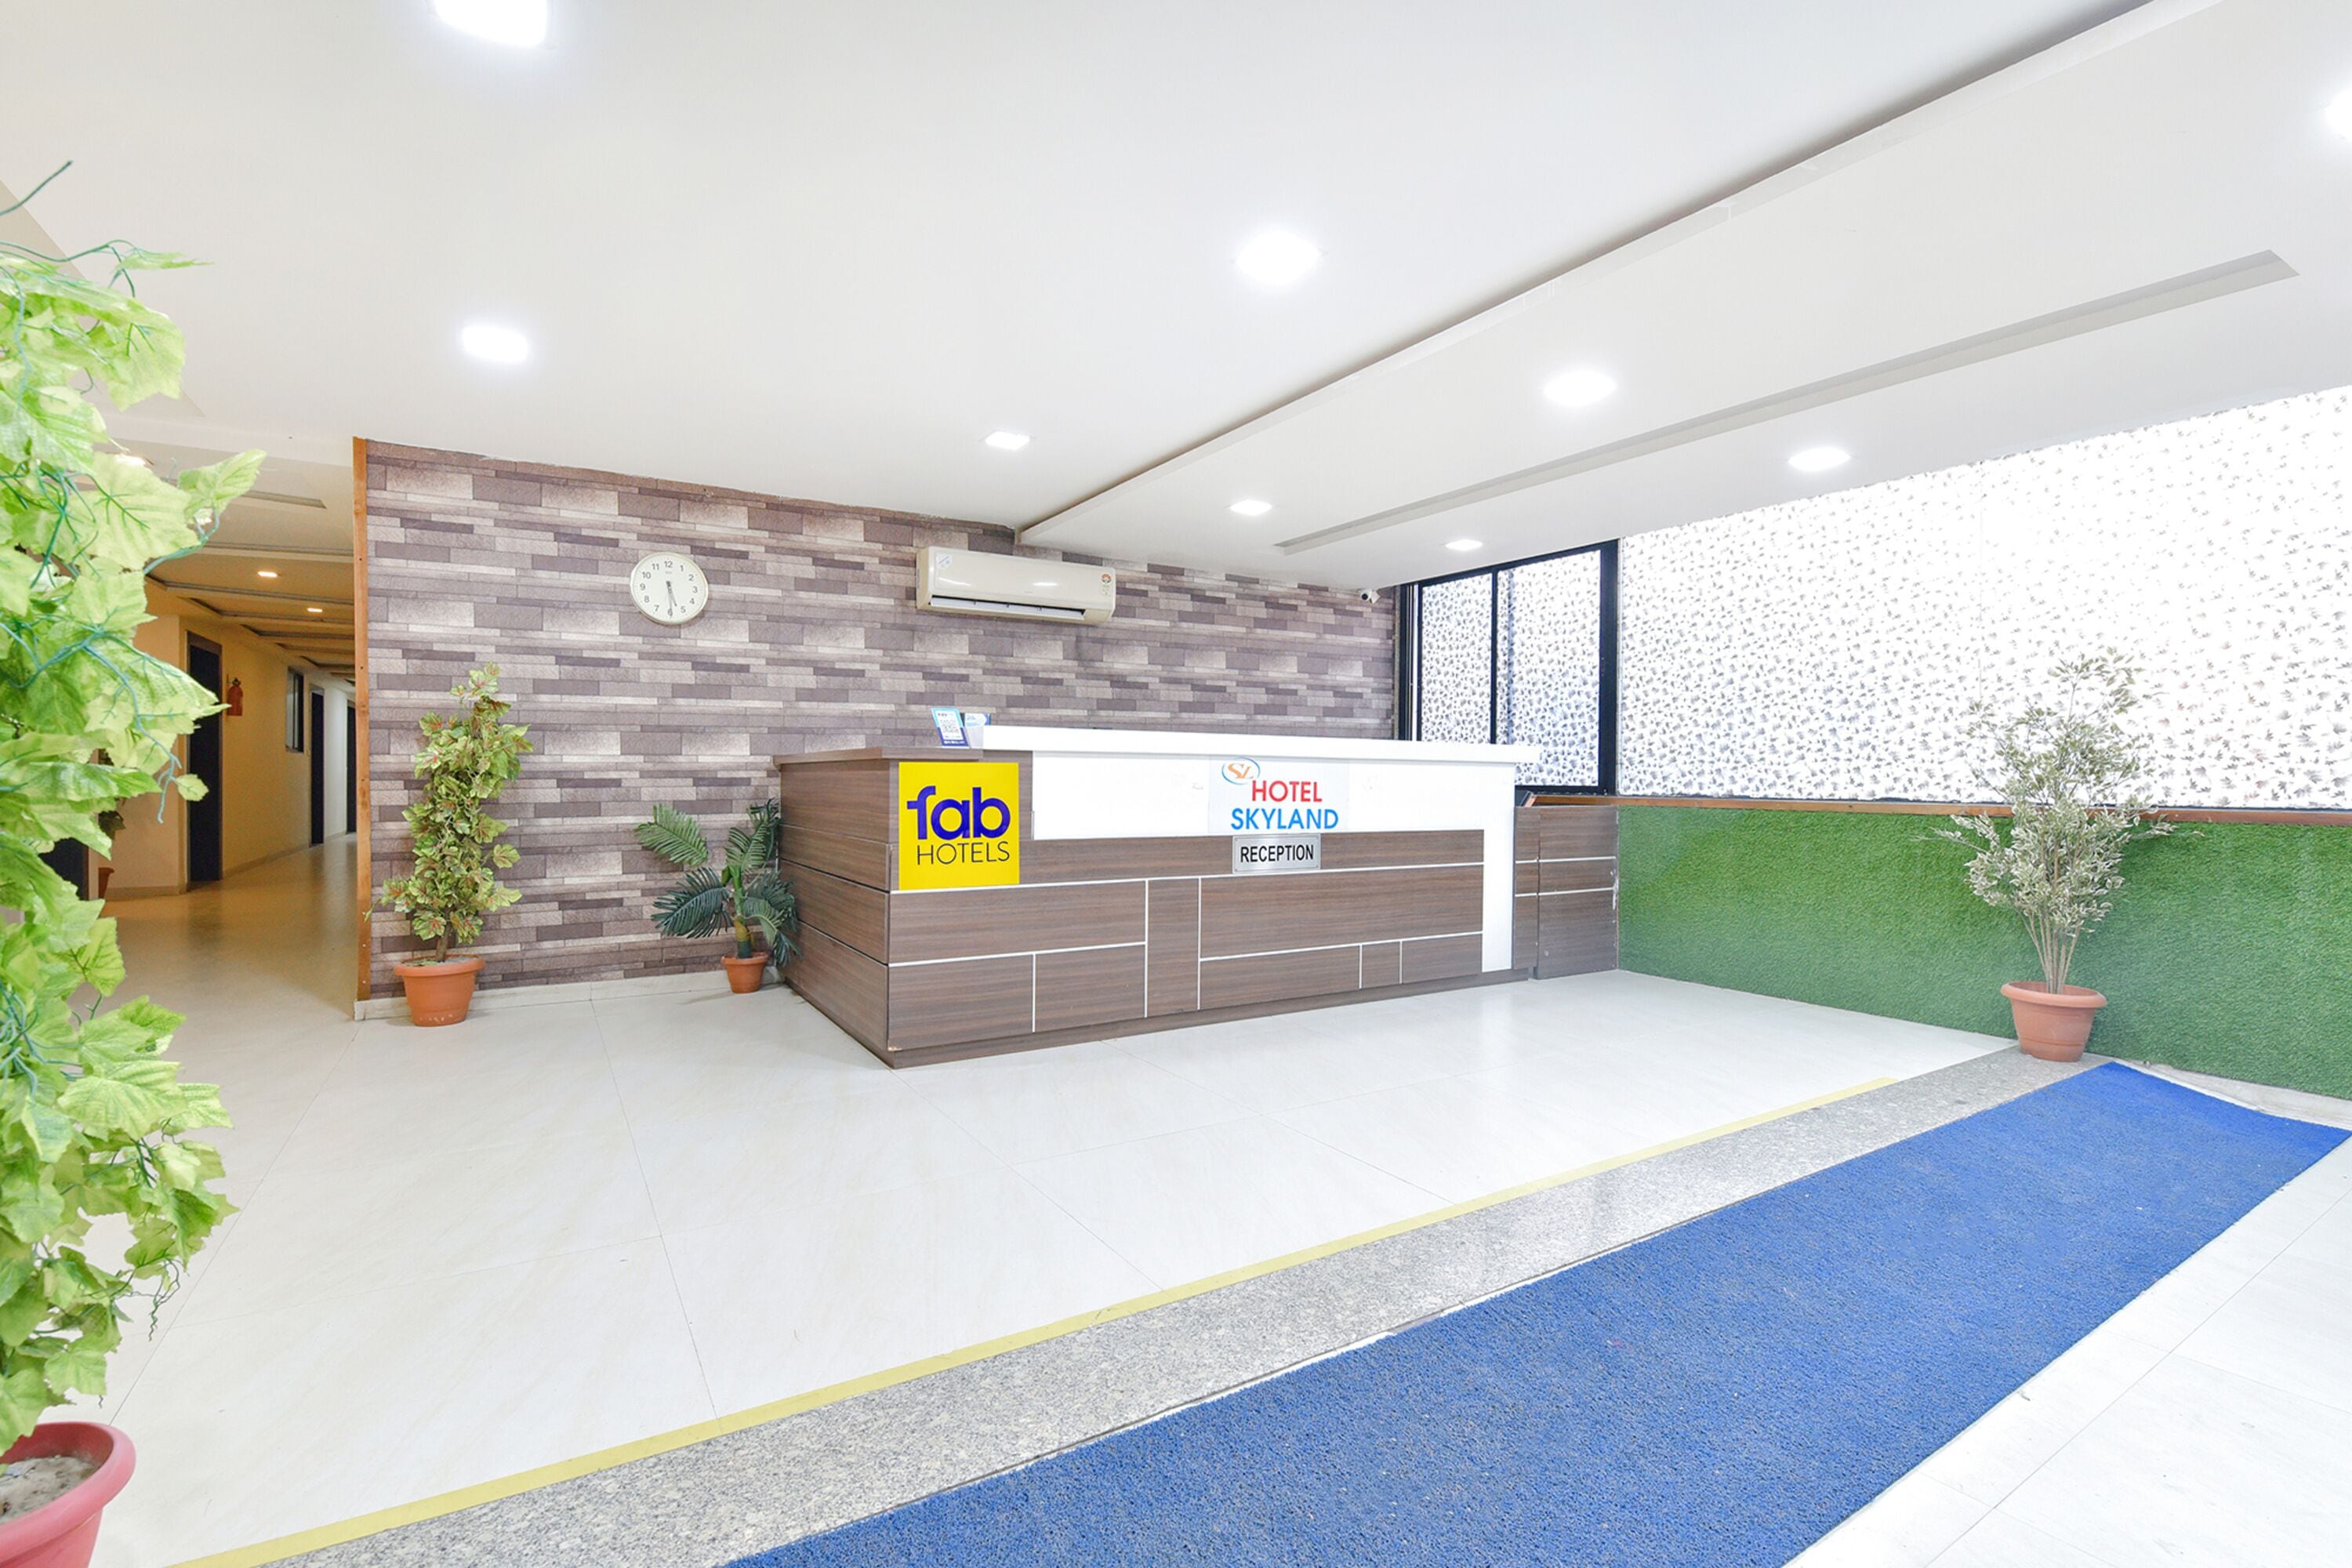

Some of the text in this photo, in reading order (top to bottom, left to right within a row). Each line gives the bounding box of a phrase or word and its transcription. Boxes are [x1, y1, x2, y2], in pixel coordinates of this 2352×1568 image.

[1251, 780, 1323, 802] HOTEL
[906, 785, 1011, 840] fab
[1231, 808, 1339, 830] SKYLAND
[916, 840, 1010, 866] HOTELS
[1240, 844, 1314, 862] RECEPTION
